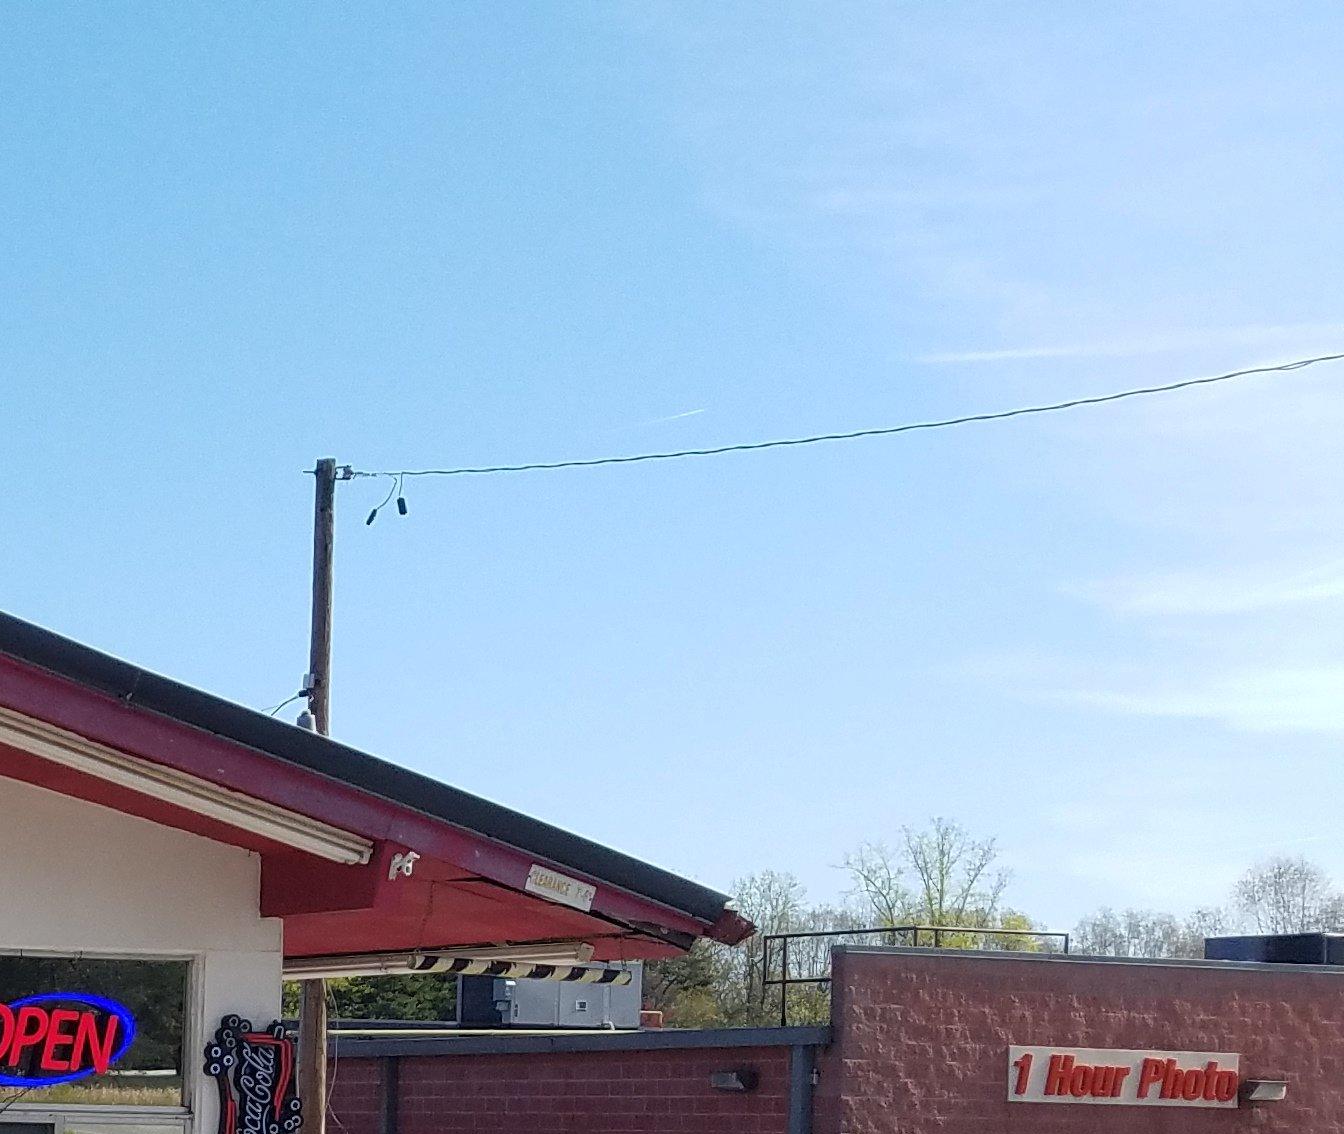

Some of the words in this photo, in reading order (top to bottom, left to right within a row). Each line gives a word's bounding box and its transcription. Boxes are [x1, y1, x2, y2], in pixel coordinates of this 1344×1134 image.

[1013, 1053, 1034, 1096] 1
[1044, 1053, 1131, 1098] Hour
[1136, 1057, 1238, 1102] Photo
